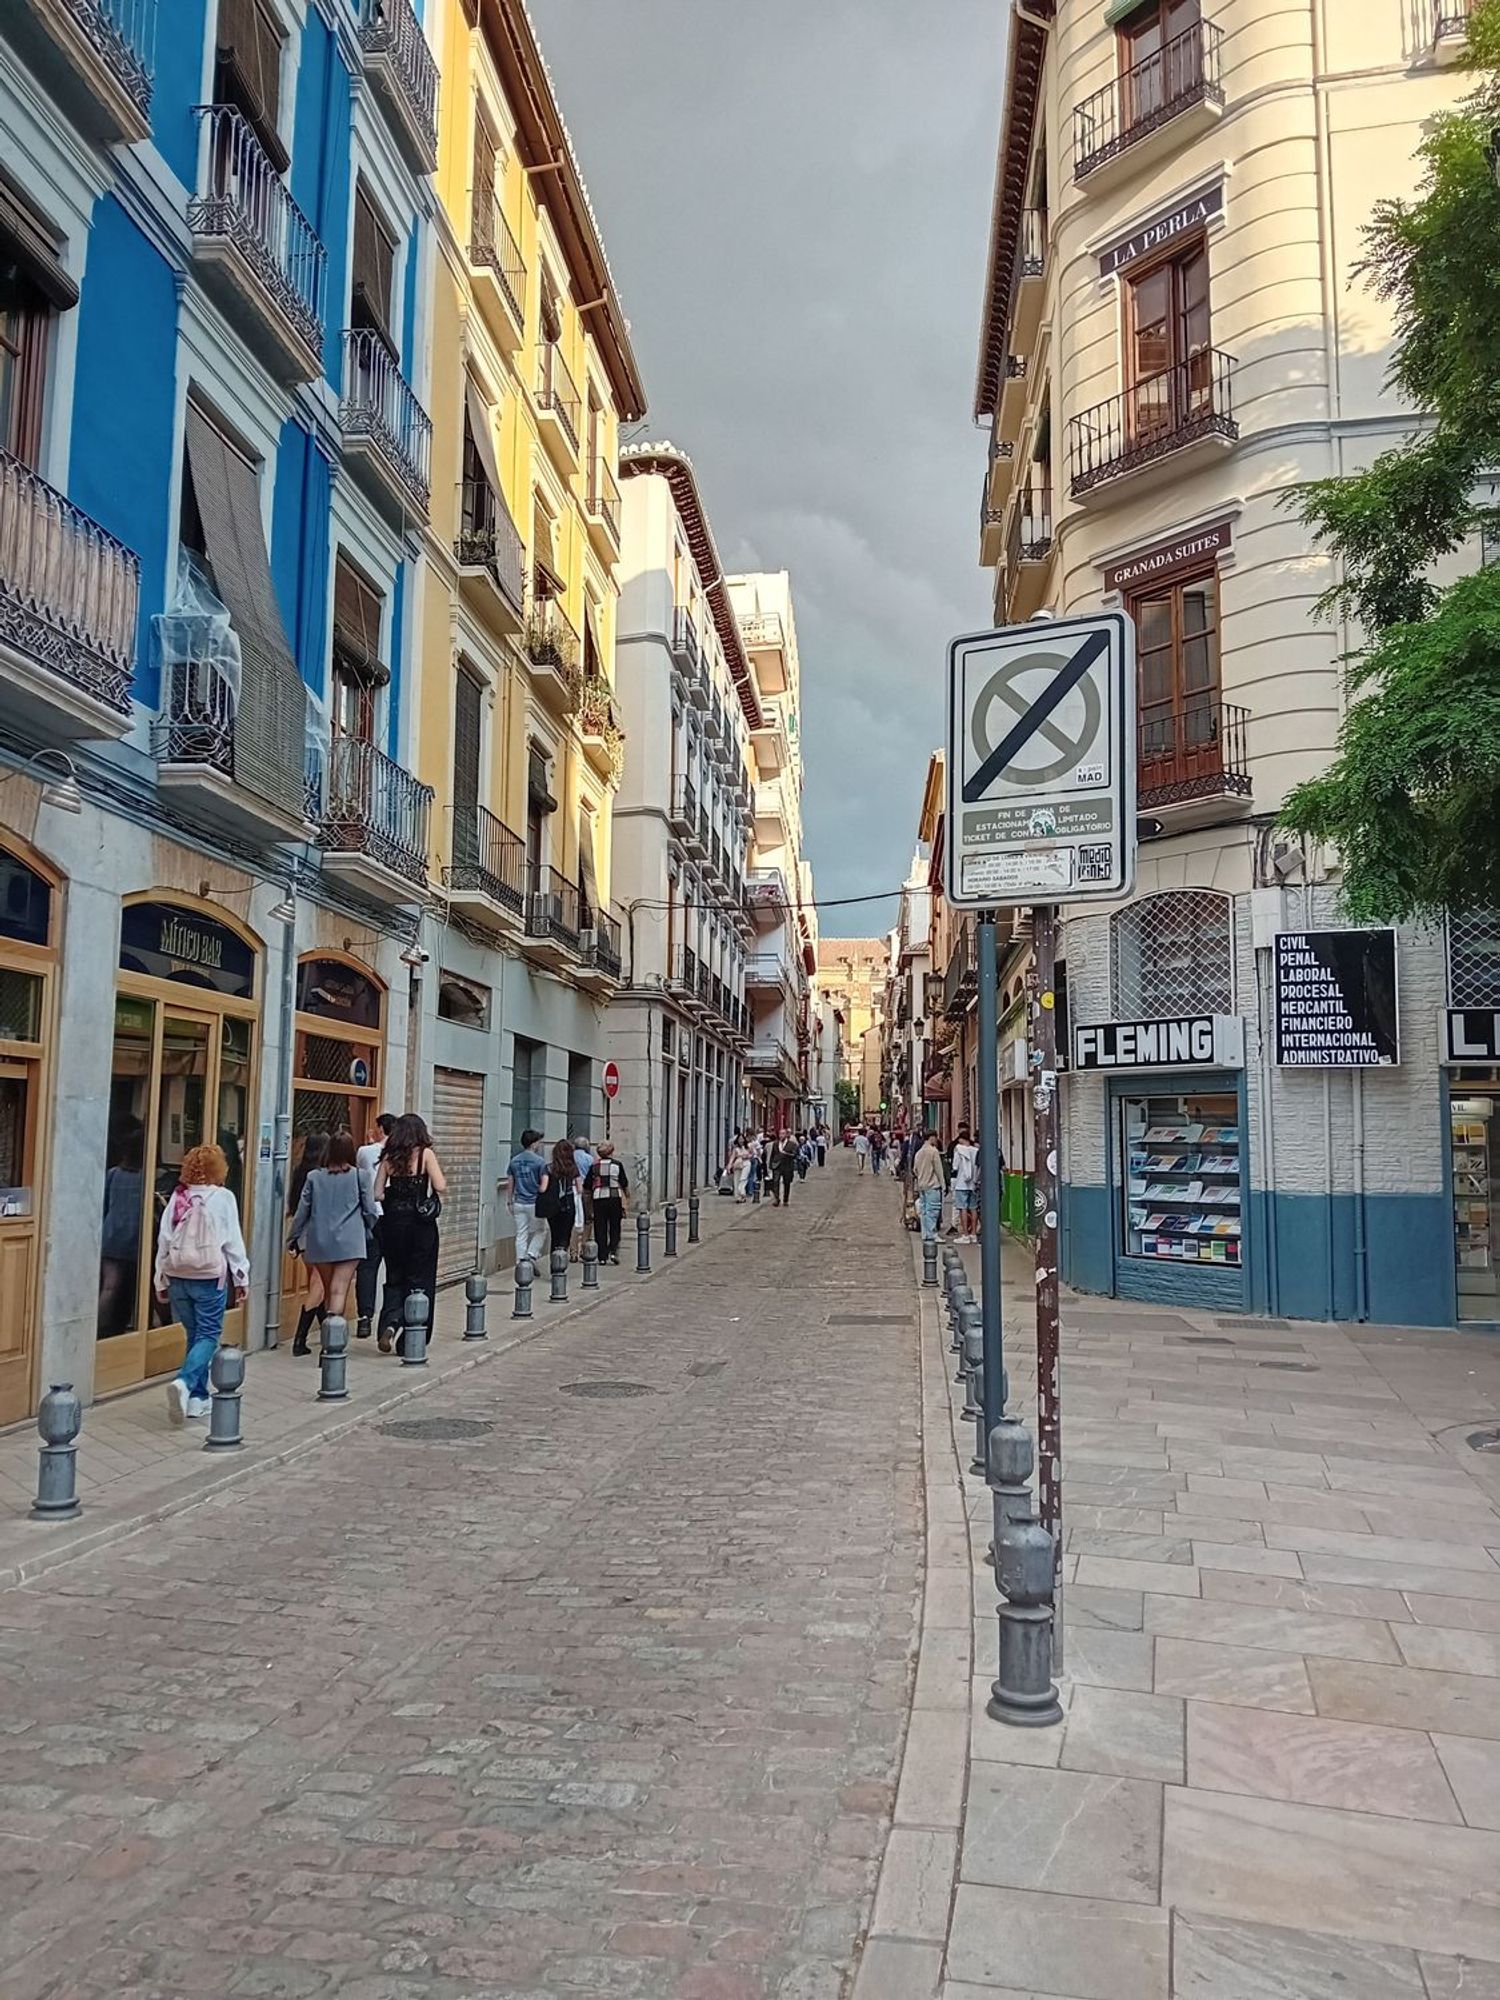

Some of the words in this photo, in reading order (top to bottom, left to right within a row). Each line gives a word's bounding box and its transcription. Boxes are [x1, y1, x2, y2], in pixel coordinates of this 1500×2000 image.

[1112, 242, 1136, 268] LA
[1142, 200, 1208, 251] PERLA
[1114, 552, 1173, 583] GRANADA
[1174, 533, 1220, 560] SUITES
[1077, 772, 1103, 783] MAD
[997, 811, 1011, 819] FIN
[1015, 809, 1026, 817] DE
[1059, 805, 1071, 813] DE
[1057, 812, 1098, 824] LIMITADO
[963, 833, 991, 843] TICKET
[1055, 822, 1111, 834] OBLIGATORIO
[1279, 936, 1310, 950] CIVIL
[200, 935, 222, 968] BAR
[1280, 952, 1319, 966] PENAL
[1280, 968, 1336, 982] LABORAL
[1280, 984, 1344, 998] PROCESAL
[1281, 1000, 1348, 1015] MERCANTIL
[1281, 1016, 1353, 1031] FINANCIERO
[1077, 1020, 1212, 1067] FLEMING
[1282, 1032, 1377, 1047] INTERNACIONAL
[1282, 1049, 1379, 1064] ADMINISTRATIVO
